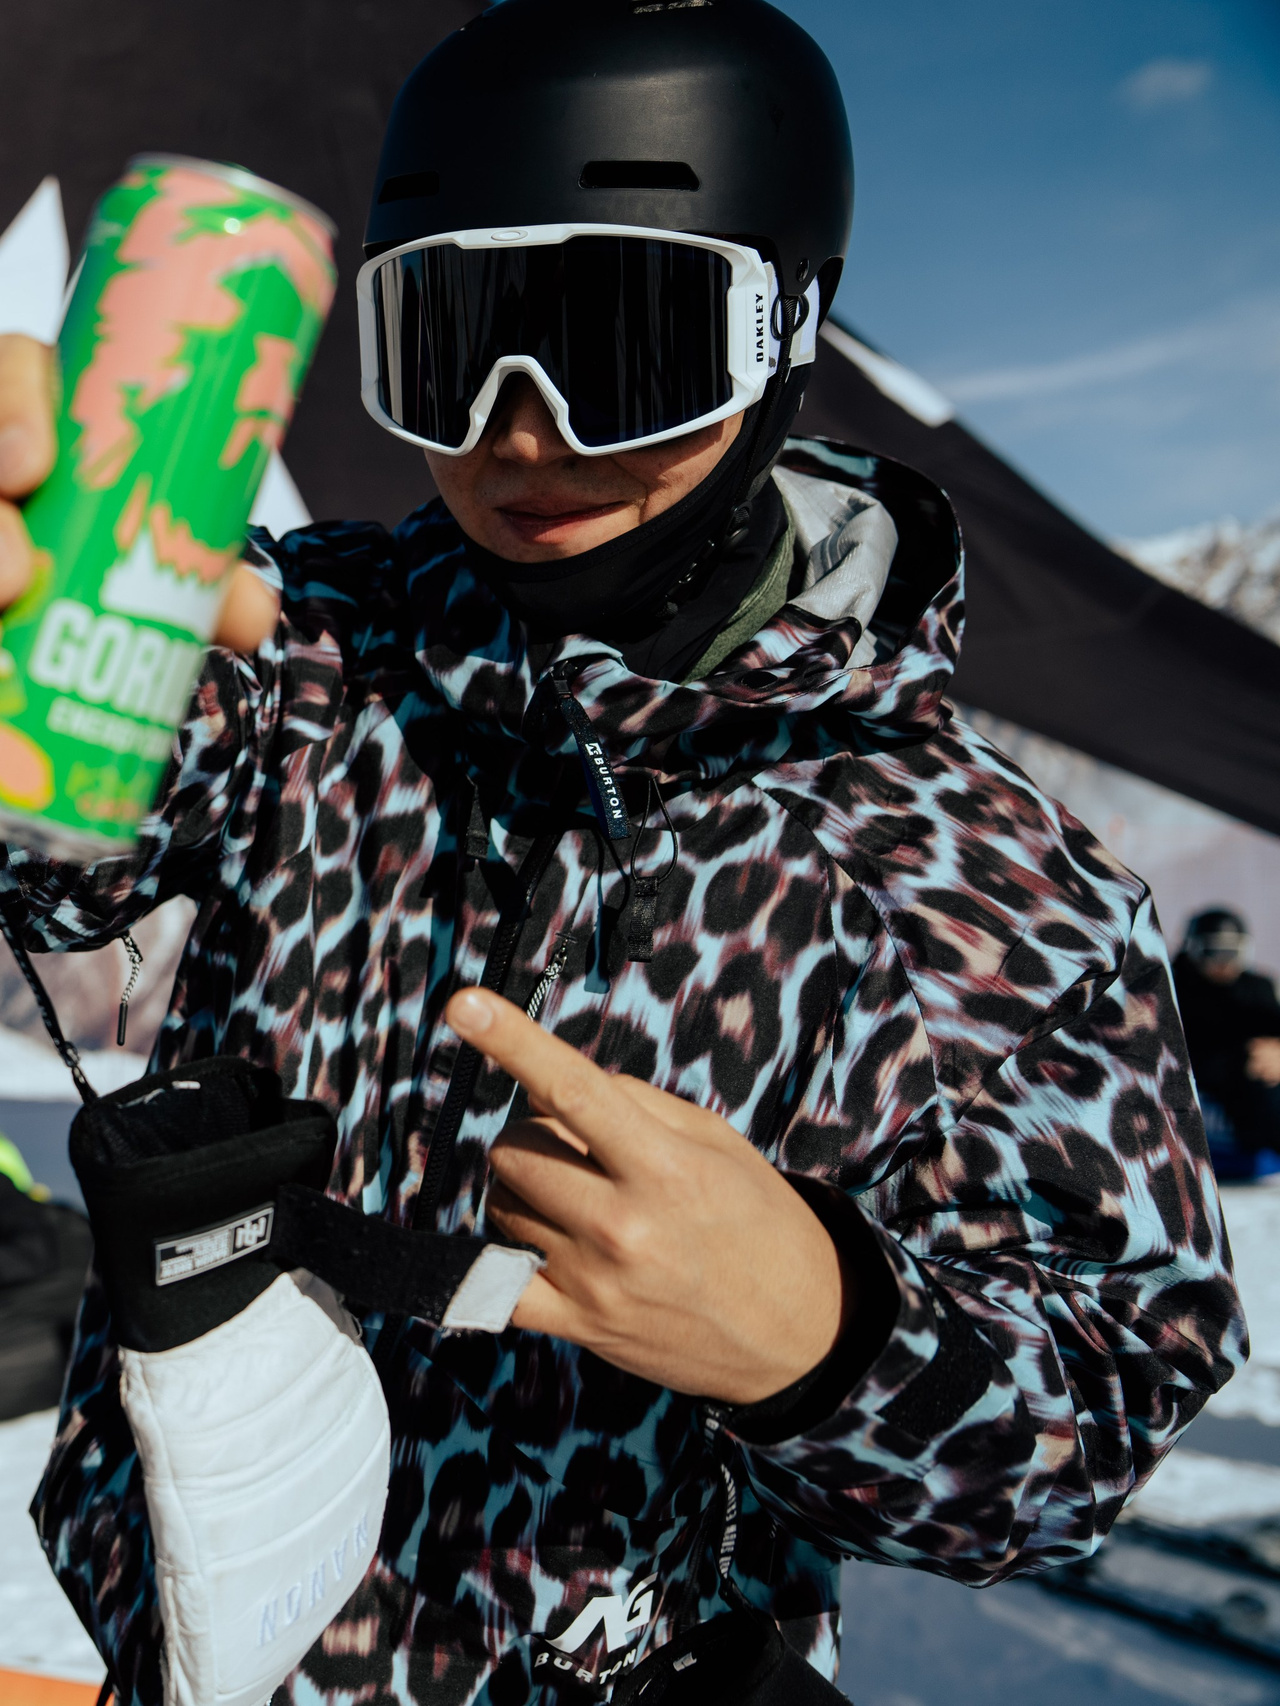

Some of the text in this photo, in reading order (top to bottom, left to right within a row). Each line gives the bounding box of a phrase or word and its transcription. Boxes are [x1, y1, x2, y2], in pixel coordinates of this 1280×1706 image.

[755, 293, 765, 363] OAKLEY
[593, 757, 623, 819] BURTON
[533, 1648, 638, 1686] BURTON
